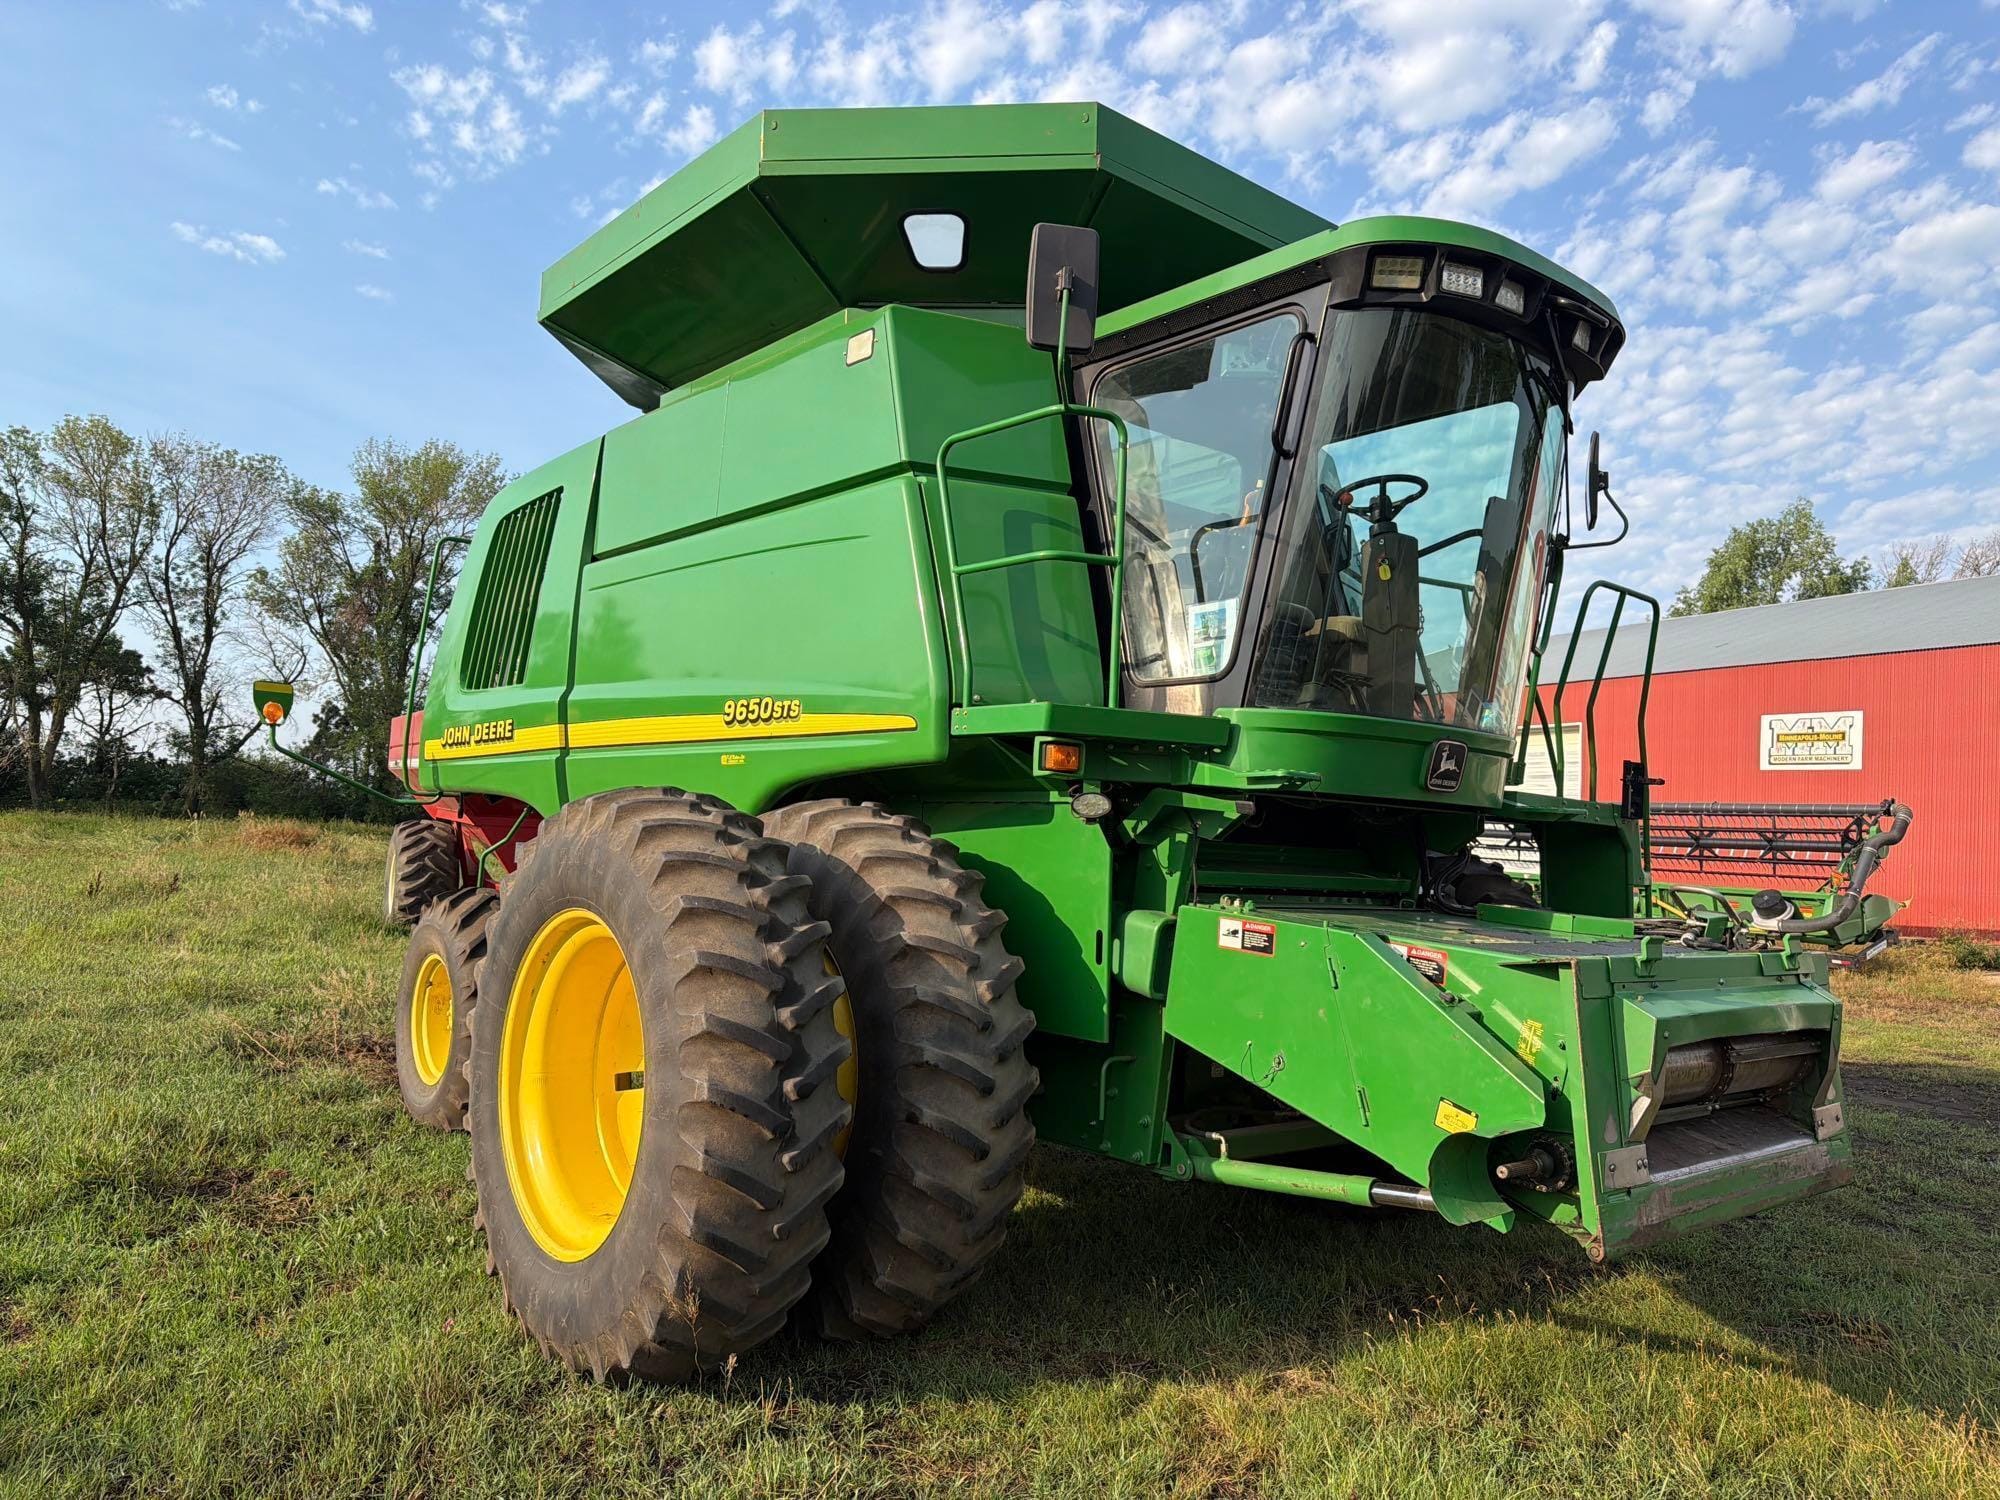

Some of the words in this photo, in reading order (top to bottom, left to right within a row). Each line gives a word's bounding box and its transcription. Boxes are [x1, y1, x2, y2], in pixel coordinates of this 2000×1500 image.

[723, 696, 801, 726] 9650STS
[440, 725, 471, 747] JOHN
[474, 719, 513, 744] DEERE
[1249, 924, 1271, 932] DANGER
[1416, 949, 1443, 959] DANGER
